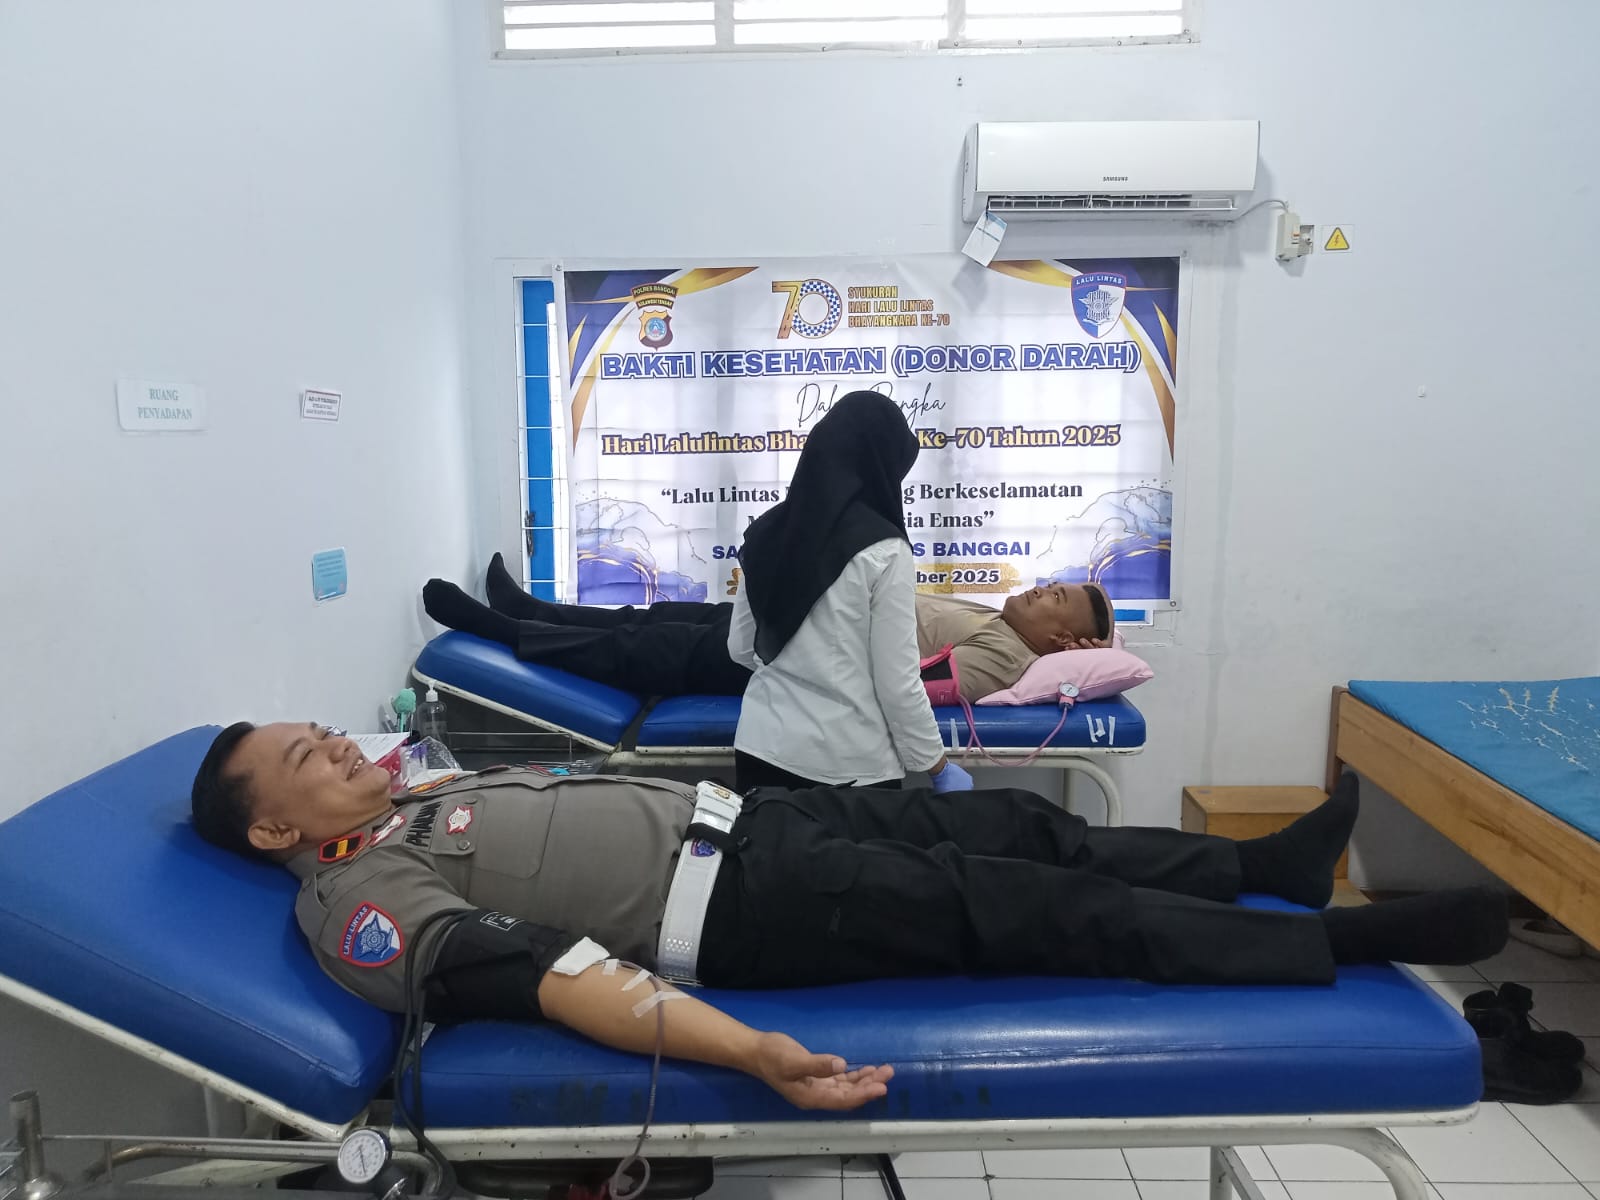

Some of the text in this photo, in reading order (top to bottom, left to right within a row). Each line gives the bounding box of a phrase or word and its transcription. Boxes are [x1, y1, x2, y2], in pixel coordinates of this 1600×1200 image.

[1076, 275, 1122, 285] LALU LINTAS
[634, 286, 653, 296] POLRES
[848, 286, 898, 299] SYUKURAN
[772, 279, 842, 339] 70
[848, 299, 934, 313] HARI LALU LINTAS
[848, 314, 950, 327] BHAYANGKARA KE-70
[600, 341, 1141, 379] BAKTI KESEHATAN (DONOR DARAH)
[149, 388, 179, 402] RUANG
[797, 382, 838, 428] Dal
[137, 406, 193, 420] PENYADAPAN
[602, 434, 653, 455] Hari
[654, 432, 766, 454] Lalulintas
[915, 427, 985, 449] Ke-70
[987, 425, 1060, 448] Tahun
[1062, 424, 1121, 446] 2025
[661, 488, 714, 504] “Lalu
[719, 486, 780, 502] Lintas
[920, 482, 1083, 499] Berkeselamatan
[930, 510, 994, 528] Emas”
[933, 541, 1030, 556] BANGGAI
[952, 570, 1000, 583] 2025
[343, 904, 369, 957] LALU LINTAS
